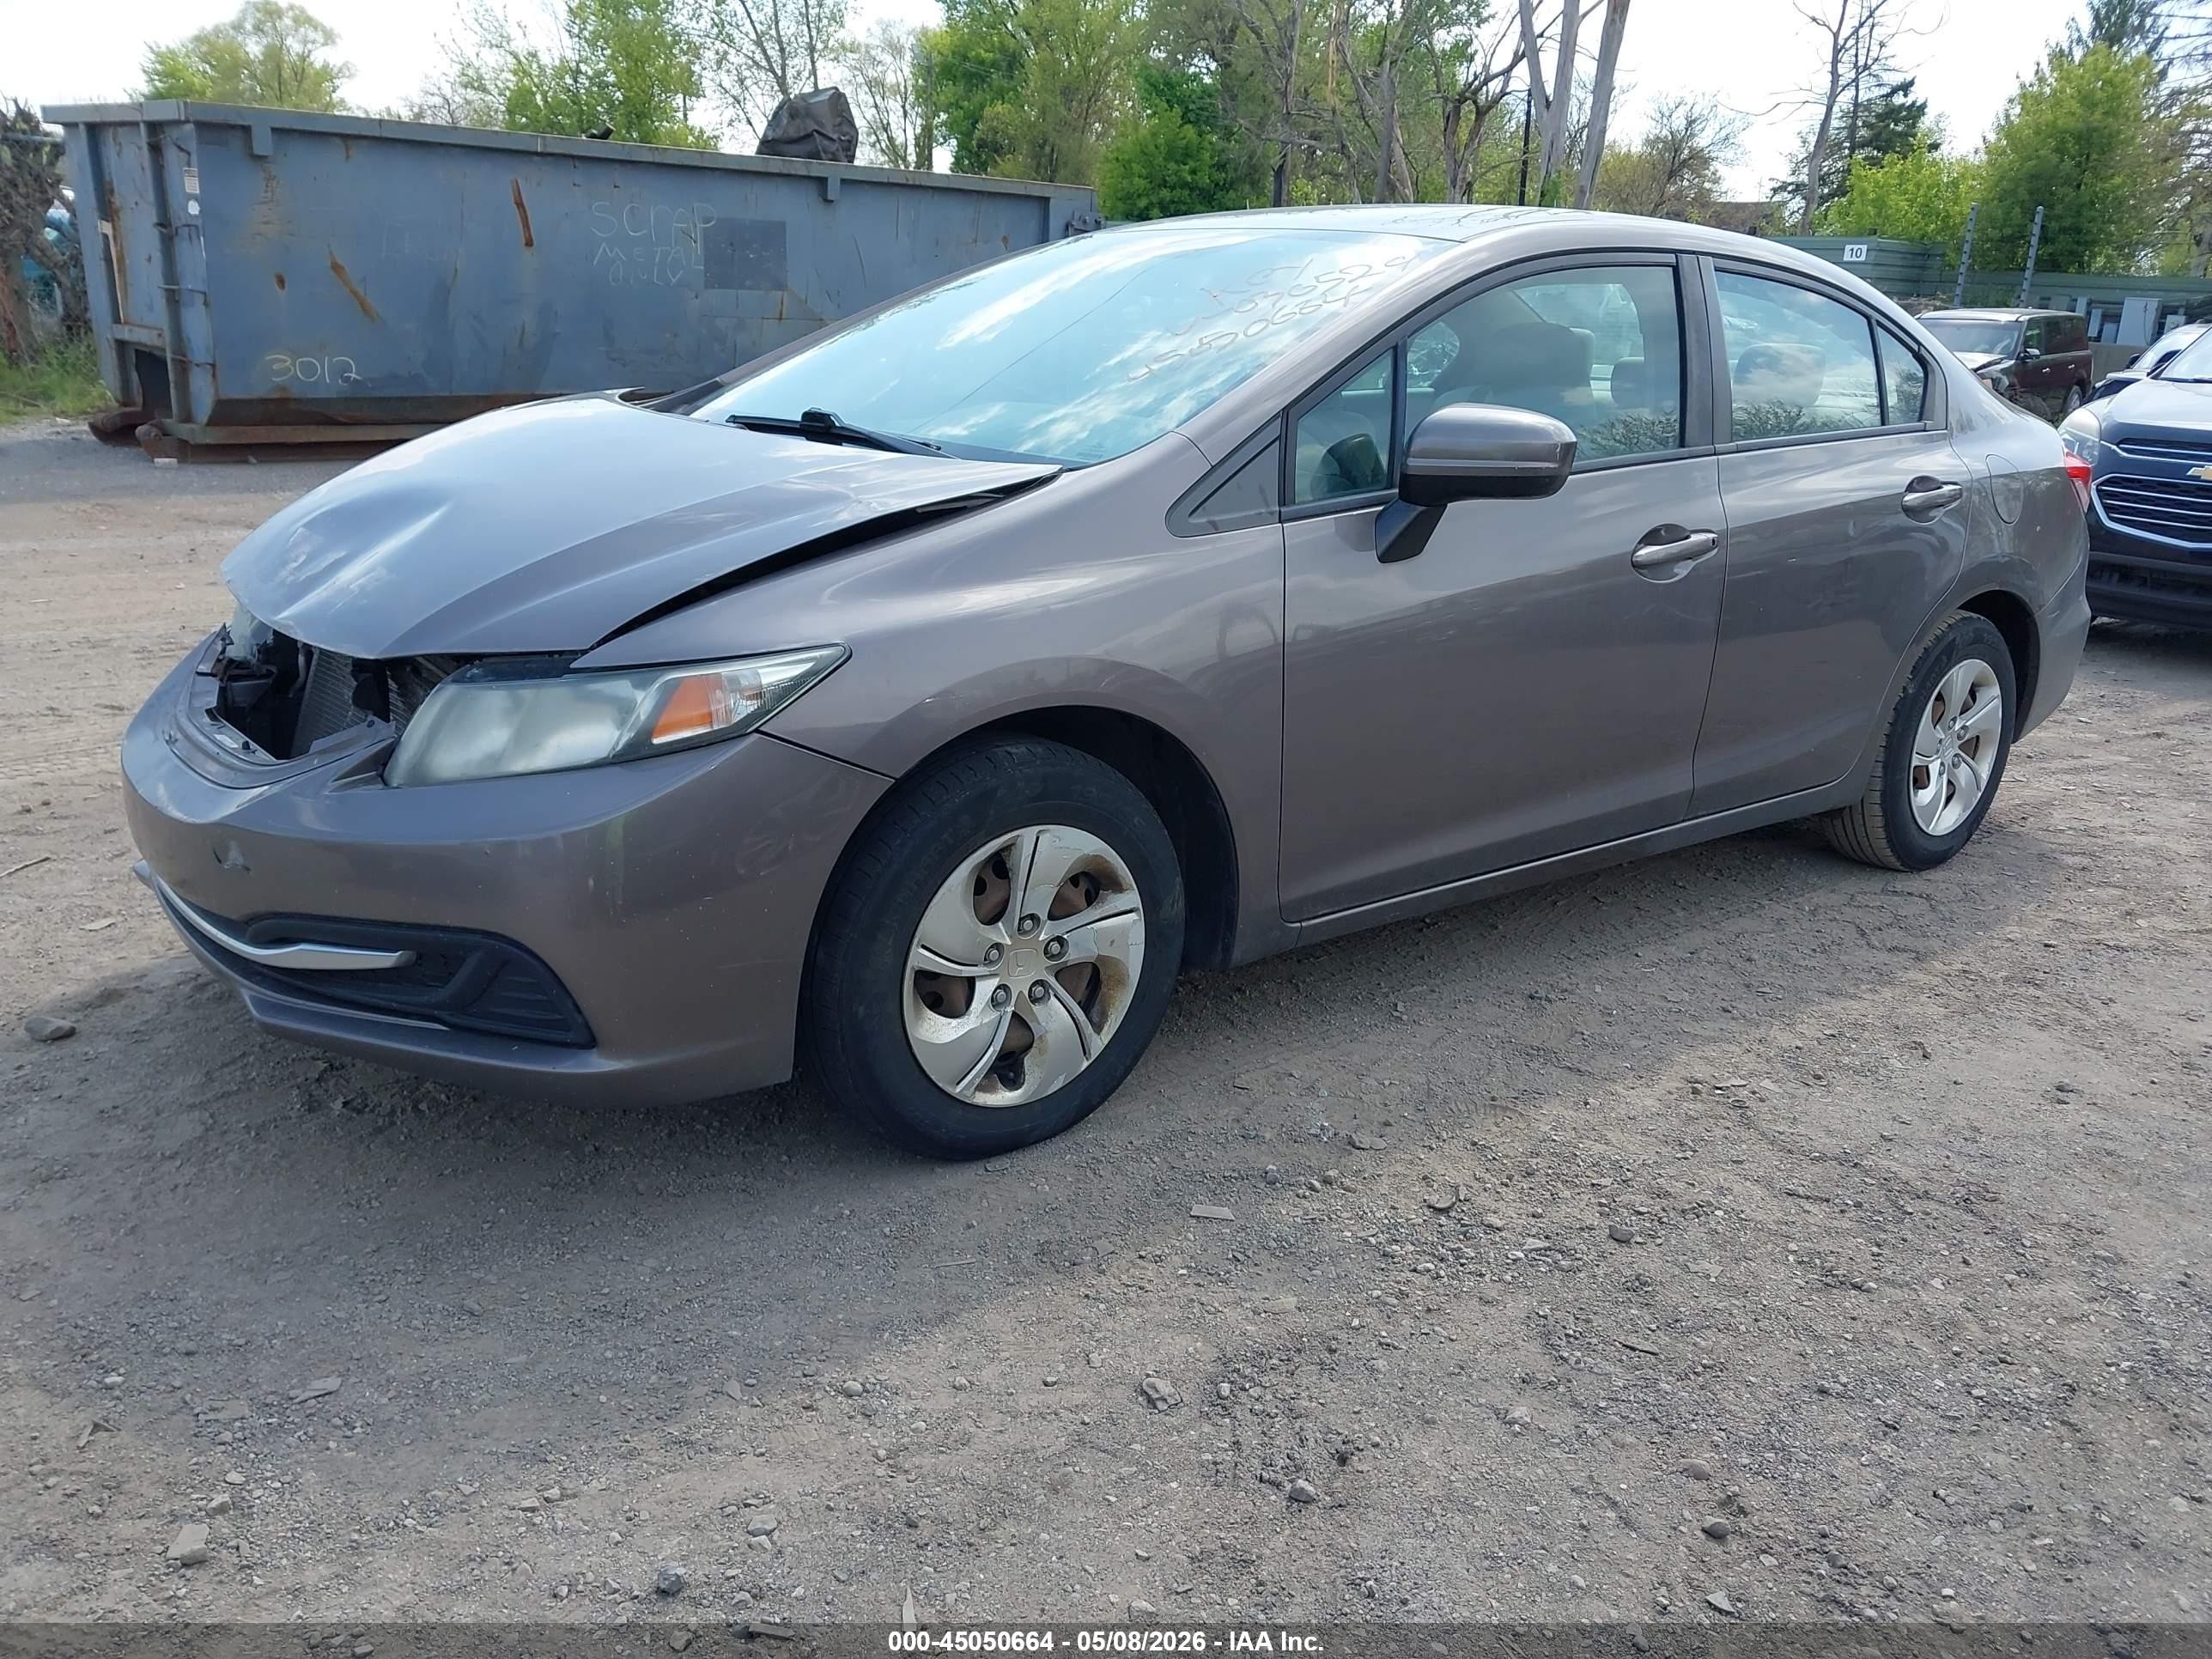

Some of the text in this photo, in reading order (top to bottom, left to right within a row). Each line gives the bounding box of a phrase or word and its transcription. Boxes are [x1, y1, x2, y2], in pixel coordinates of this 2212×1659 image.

[592, 241, 704, 269] METAL
[1848, 246, 1863, 259] 10
[264, 354, 363, 386] 3012
